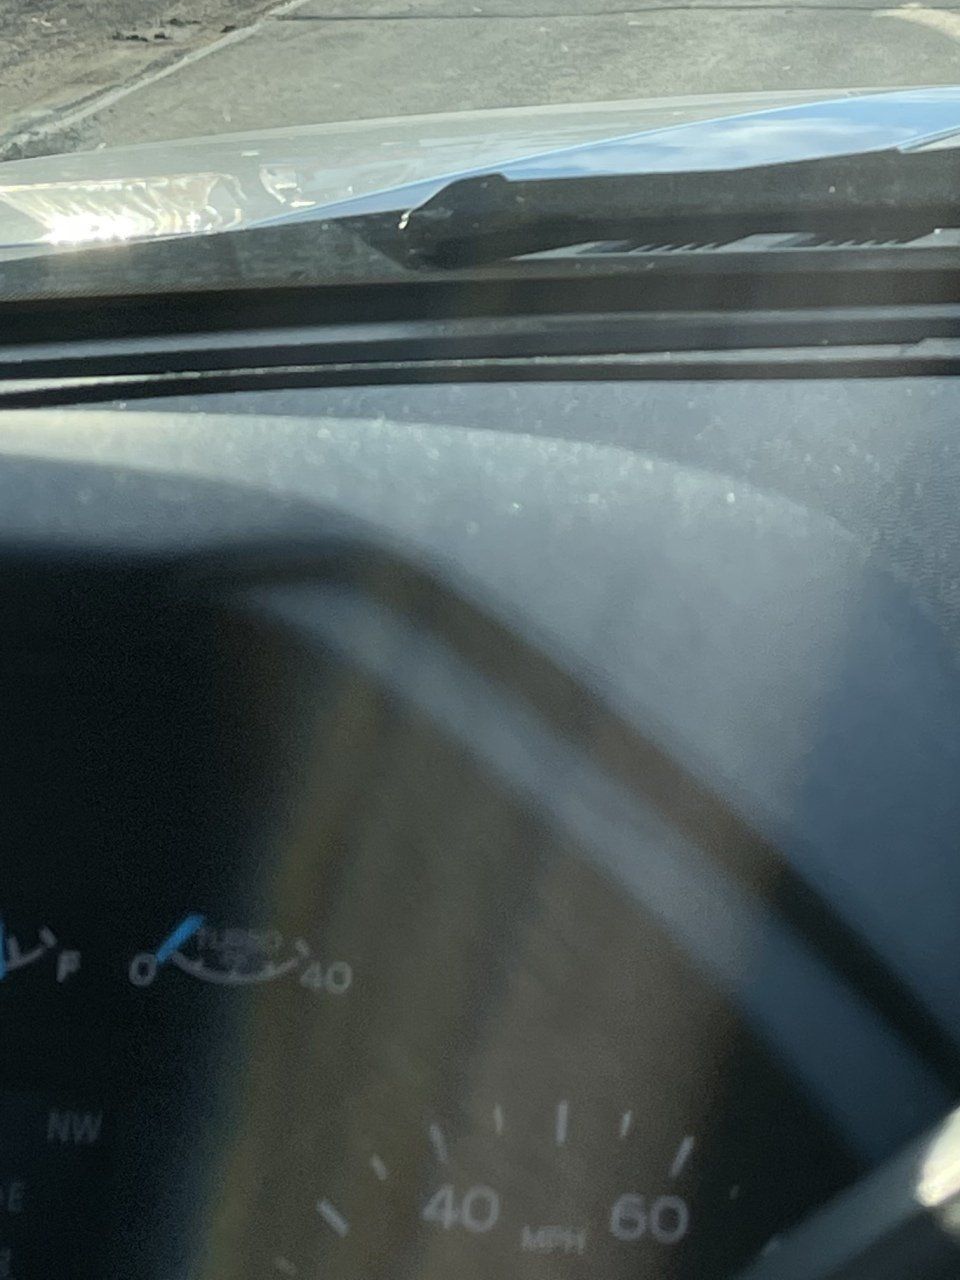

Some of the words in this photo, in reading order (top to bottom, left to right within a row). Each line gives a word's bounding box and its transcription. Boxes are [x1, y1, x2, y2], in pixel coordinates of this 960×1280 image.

[301, 960, 353, 995] 40
[47, 1108, 104, 1145] NW
[422, 1183, 500, 1234] 40
[610, 1191, 690, 1245] 60
